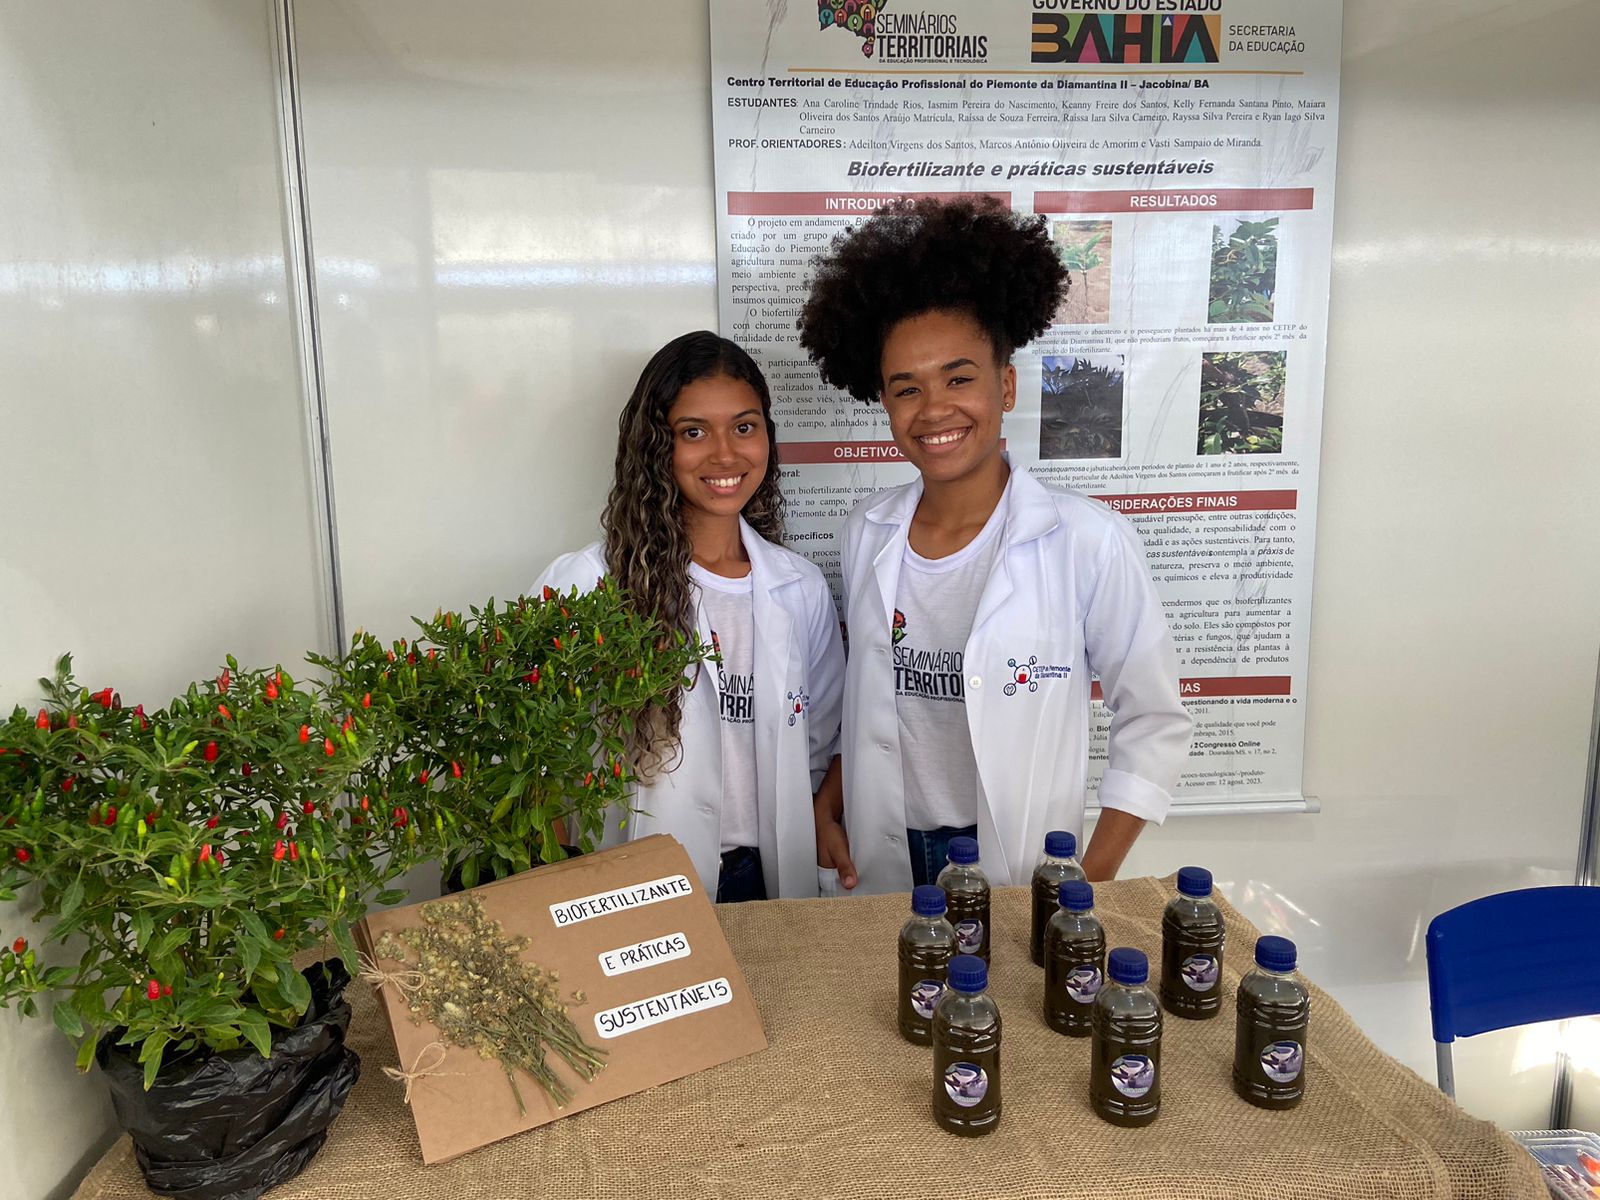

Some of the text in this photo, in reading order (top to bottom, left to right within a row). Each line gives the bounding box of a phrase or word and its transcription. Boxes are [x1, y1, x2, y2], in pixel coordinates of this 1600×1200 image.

[1033, 0, 1222, 11] GOVERNO DO ESTADO
[876, 11, 957, 34] SEMINÁRIOS
[1229, 25, 1296, 37] SECRETARIA
[1031, 13, 1221, 63] BAHIA
[877, 35, 988, 58] TERRITORIAIS
[1228, 40, 1305, 54] DA EDUCAÇÃO
[726, 77, 765, 88] Centro
[767, 77, 824, 87] Territorial
[827, 77, 841, 87] de
[844, 78, 898, 89] Educação
[901, 79, 966, 88] Profissional
[969, 79, 983, 88] do
[986, 79, 1037, 88] Piemonte
[1040, 79, 1053, 88] da
[1056, 79, 1116, 89] Diamantina
[1120, 80, 1127, 89] II
[1139, 79, 1191, 89] Jacobina/
[1194, 79, 1209, 88] BA
[727, 98, 1326, 111] ESTUDANTES: Ana Caroline Trindade Rios, Iasmim Pereira do Nascimento, Keanny Freire dos Santos, Kelly Fernanda Santana Pinto, Maiara
[799, 112, 833, 121] Oliveira
[835, 112, 851, 122] dos
[853, 112, 880, 122] Santos
[986, 113, 997, 122] de
[999, 113, 1024, 122] Souza
[1026, 113, 1061, 124] Ferreira,
[1091, 113, 1106, 122] Iara
[1109, 113, 1130, 122] Silva
[1132, 112, 1170, 123] Carneiro,
[1172, 112, 1200, 124] Rayssa
[1202, 112, 1223, 121] Silva
[1225, 112, 1253, 121] Pereira
[1262, 112, 1282, 123] Ryan
[1284, 112, 1302, 123] Iago
[1303, 112, 1325, 121] Silva
[800, 126, 835, 134] Carneiro
[728, 139, 759, 148] PROF.
[849, 140, 890, 149] Adeilton
[890, 140, 924, 152] Virgens
[926, 140, 942, 149] dos
[944, 140, 977, 151] Santos,
[979, 140, 1012, 149] Marcos
[1052, 139, 1087, 149] Oliveira
[1089, 139, 1100, 149] de
[1101, 139, 1139, 149] Amorim
[1149, 139, 1170, 148] Vasti
[1173, 138, 1212, 150] Sampaio
[1213, 138, 1225, 147] de
[1226, 138, 1263, 147] Miranda.
[848, 159, 1215, 179] Biofertilizante e práticas sustentáveis
[1130, 195, 1217, 207] RESULTADOS
[747, 218, 756, 227] O
[757, 218, 788, 229] projeto
[804, 218, 853, 228] andamento,
[732, 296, 806, 306] insumos químicos.
[755, 321, 791, 330] chorume
[773, 407, 827, 416] considerando
[798, 485, 851, 494] biofertilizante
[1107, 496, 1238, 512] NSIDERAÇÕES FINAIS
[1132, 511, 1296, 525] saudável pressupõe, entre outras condições,
[1136, 527, 1150, 535] boa
[1153, 526, 1192, 537] qualidade,
[1203, 524, 1266, 536] responsabilidade
[1150, 561, 1185, 571] natureza,
[1188, 563, 1220, 571] preserva
[1233, 560, 1252, 568] meio
[1255, 559, 1294, 569] ambiente,
[1179, 610, 1219, 620] agricultura
[1224, 611, 1241, 619] para
[1245, 609, 1281, 617] aumentar
[1172, 620, 1291, 631] do solo. Eles são compostos por
[894, 646, 964, 672] SEMINÁRIO
[894, 666, 965, 698] TERRITO
[1181, 698, 1229, 707] questionando
[555, 879, 691, 924] BIOFERTILIZANTE
[605, 937, 685, 970] E PRÁTICAS
[599, 982, 728, 1032] SUSTENTÁVEIS
